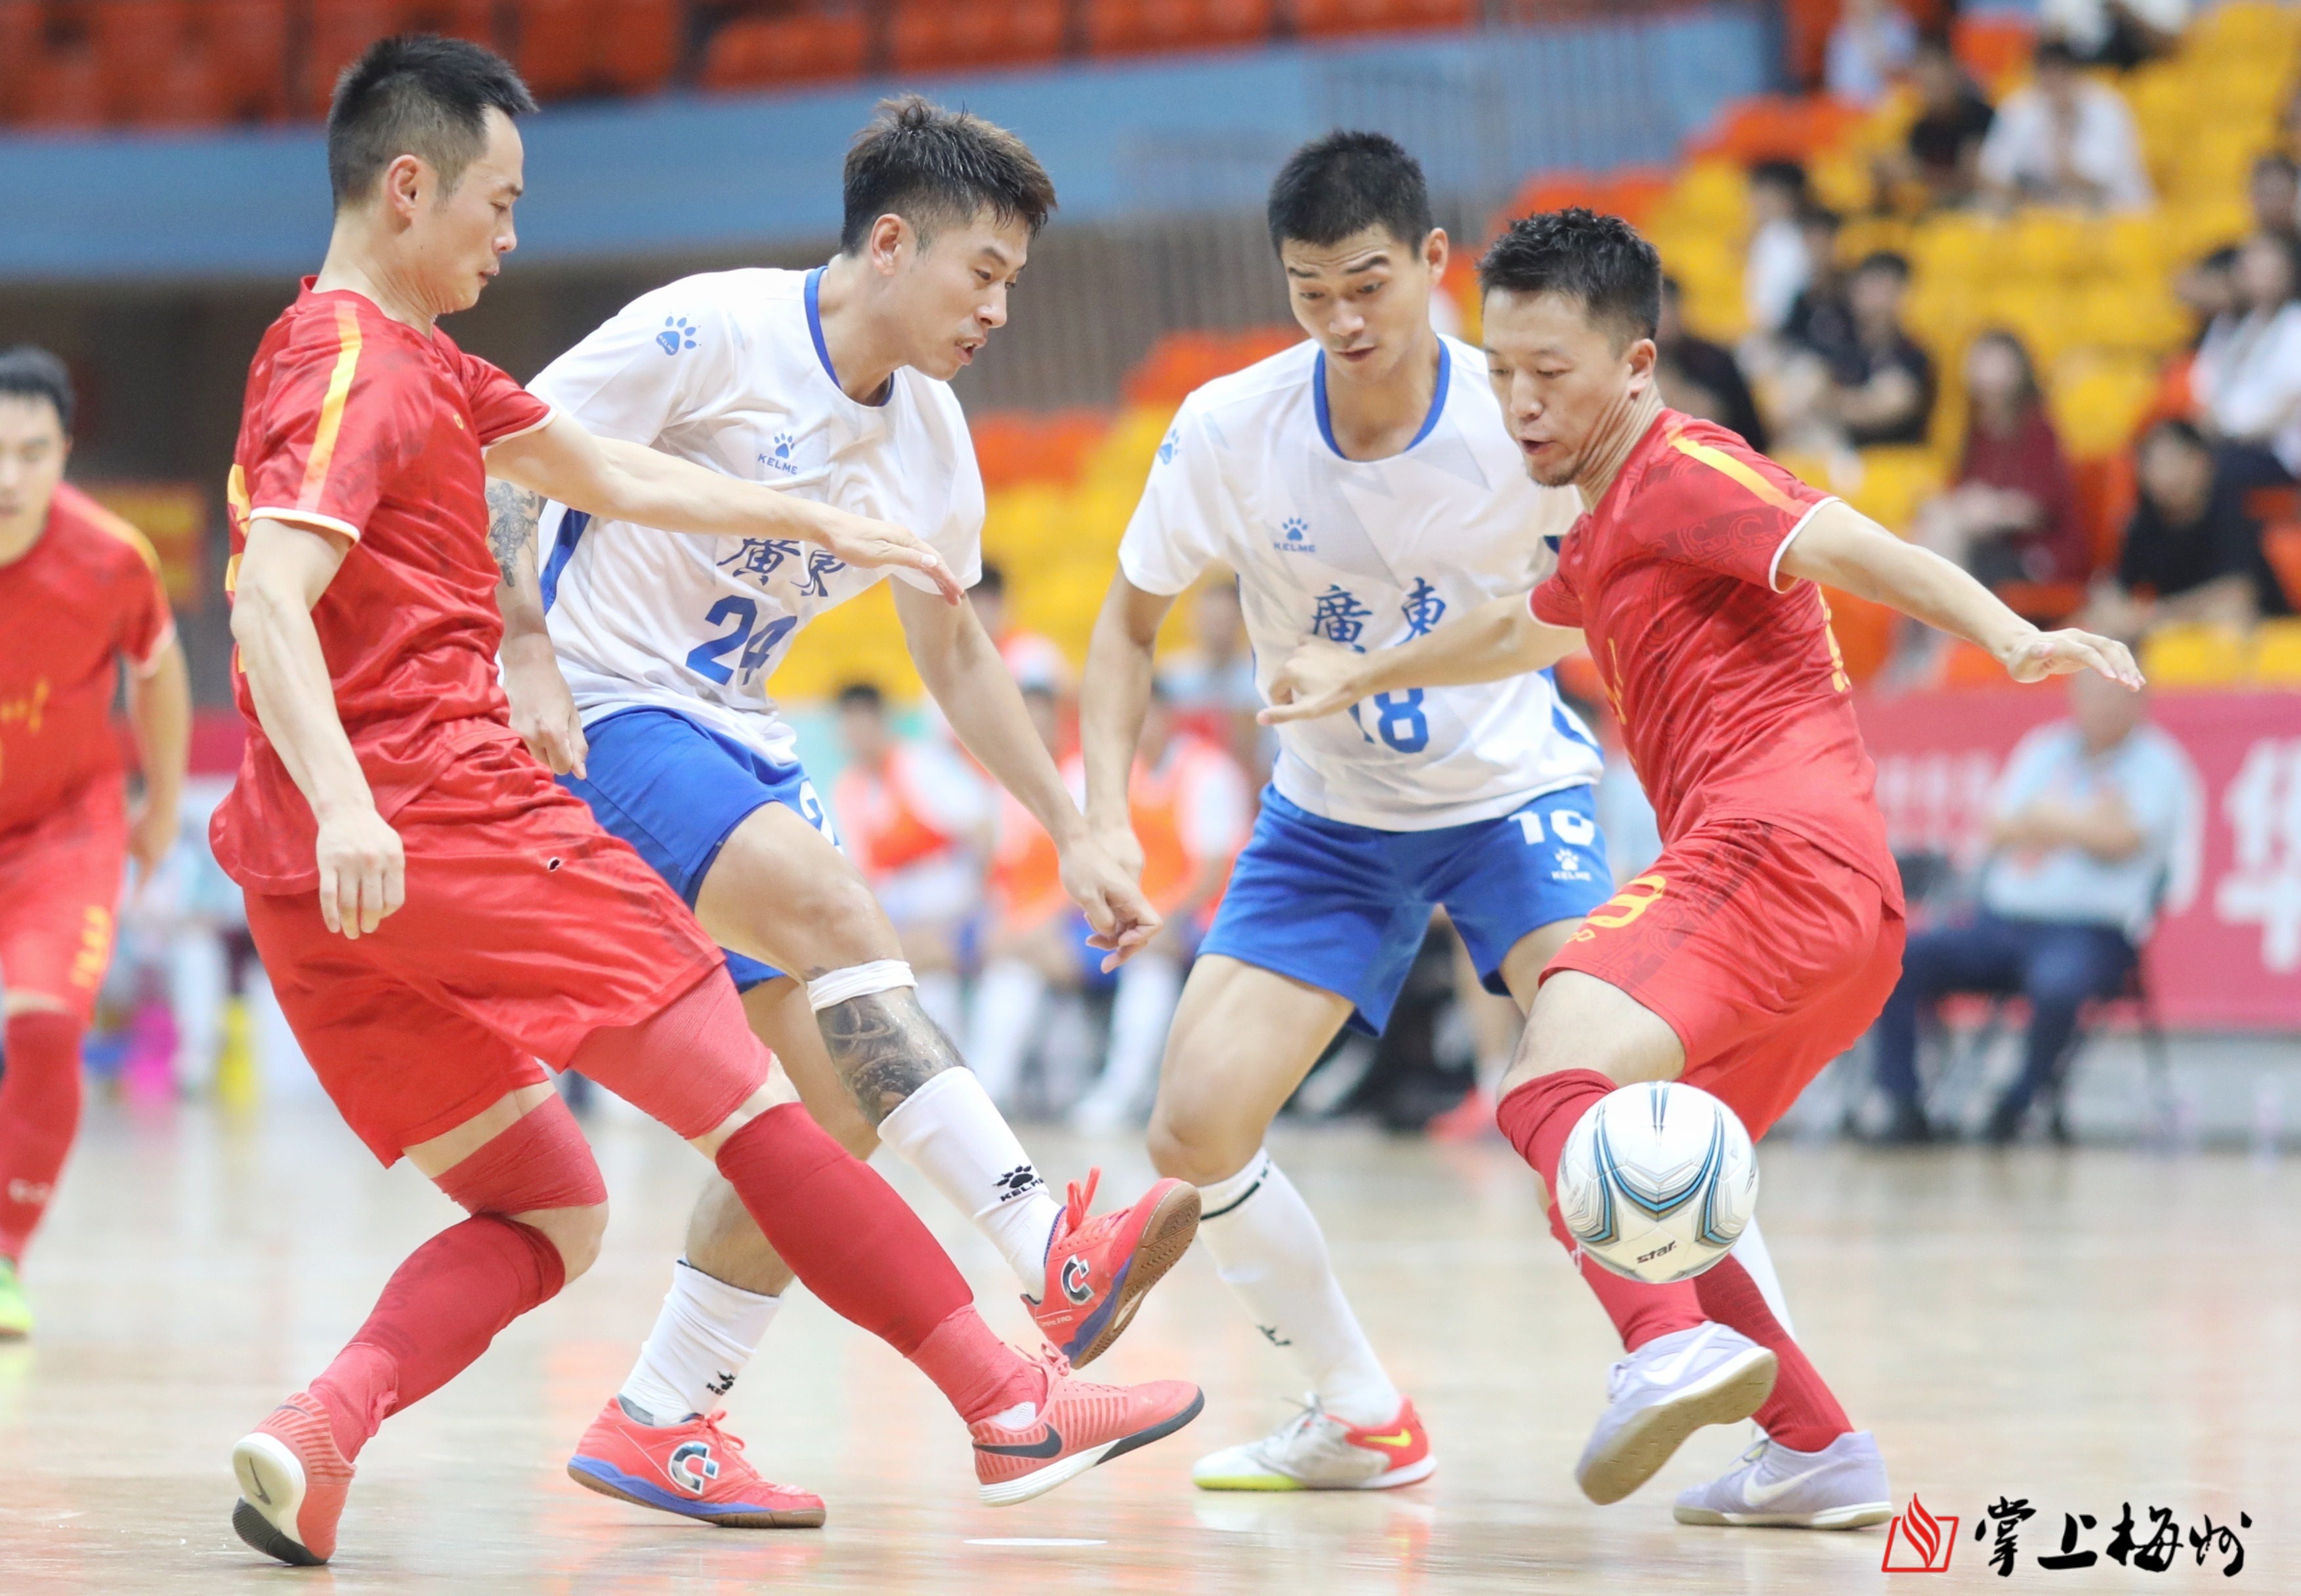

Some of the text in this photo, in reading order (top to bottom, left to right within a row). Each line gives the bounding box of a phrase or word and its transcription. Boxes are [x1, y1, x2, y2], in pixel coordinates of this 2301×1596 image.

[757, 453, 798, 475] KELME
[1273, 543, 1316, 553] KELME
[685, 594, 798, 686] 24
[798, 779, 845, 856] 2
